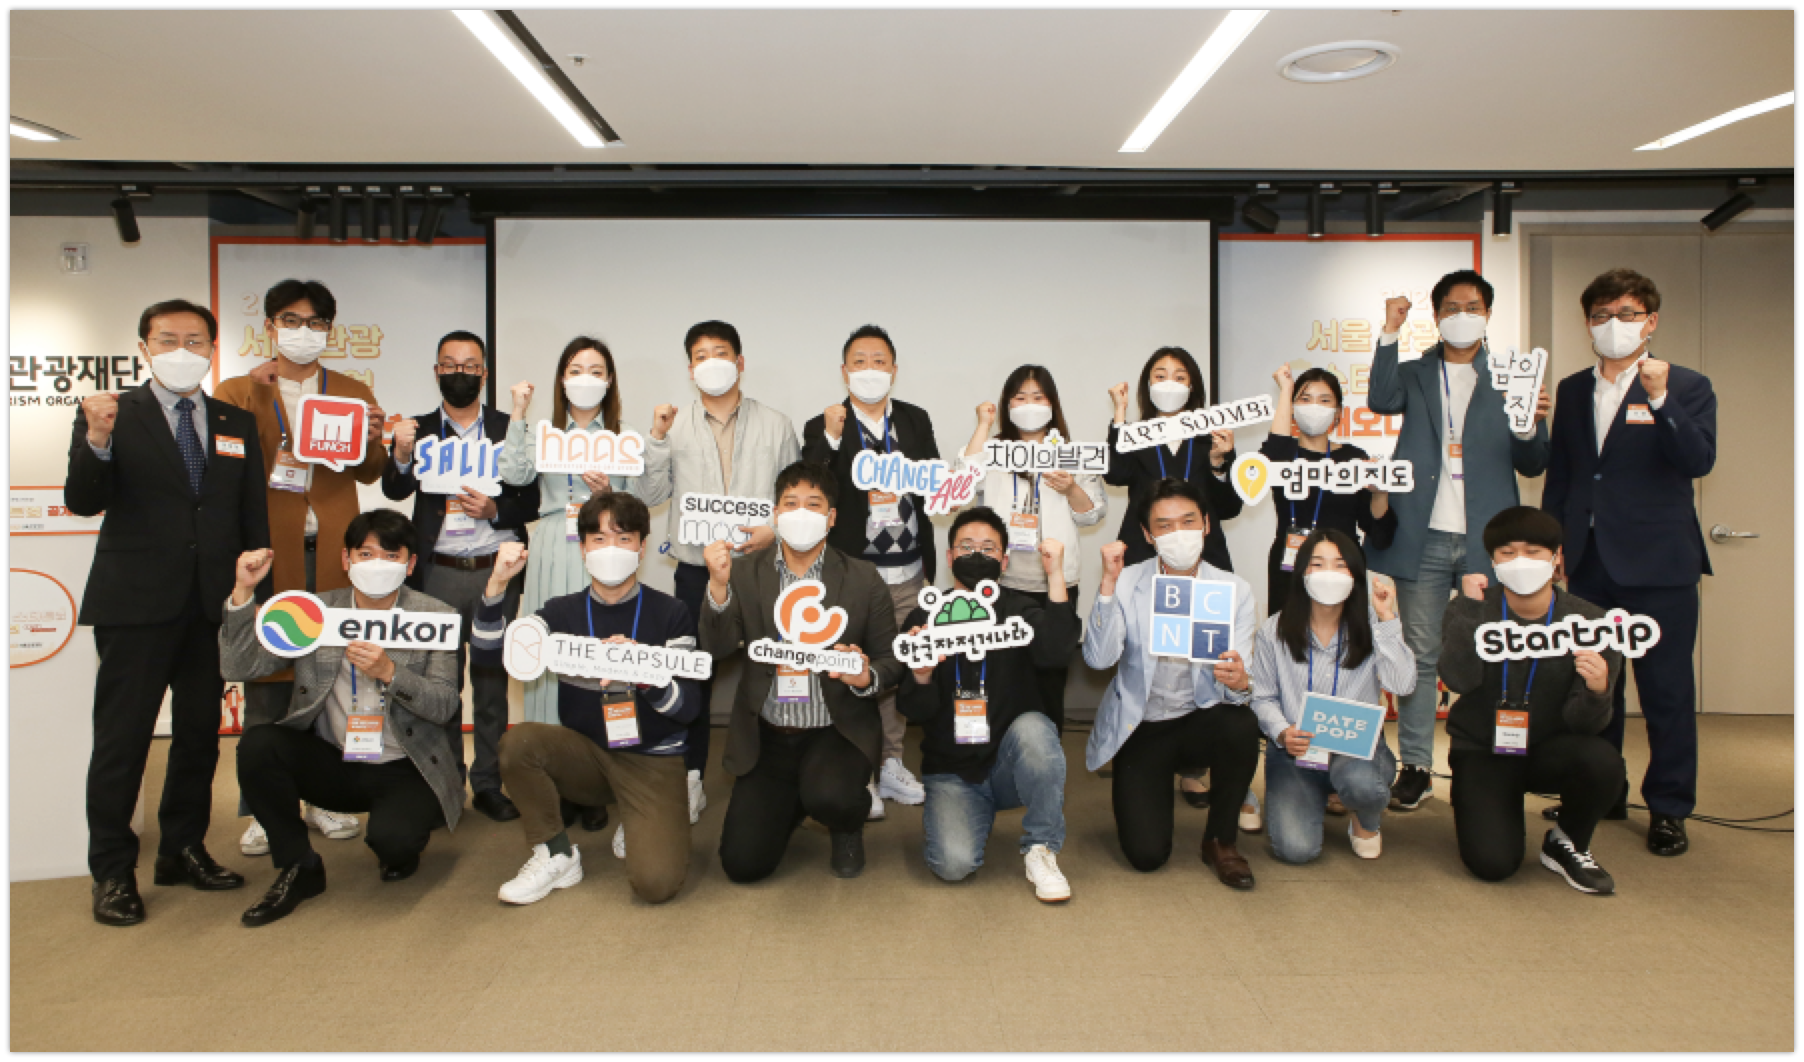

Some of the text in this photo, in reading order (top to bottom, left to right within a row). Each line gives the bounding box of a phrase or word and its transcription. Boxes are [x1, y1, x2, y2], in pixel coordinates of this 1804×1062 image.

[1306, 318, 1372, 353] 서울
[1492, 349, 1542, 389] 남의
[1509, 391, 1535, 428] 집
[309, 440, 352, 453] FUNCH
[541, 423, 641, 464] haas
[1120, 420, 1167, 450] ART
[983, 443, 1105, 471] 차이의발견
[857, 453, 945, 492] CHANGE
[1279, 464, 1409, 494] 엄마의지도
[685, 497, 771, 518] success
[338, 613, 454, 643] enkor
[899, 622, 1028, 663] 한국자전거나라
[555, 639, 706, 674] THE CAPSULE
[1312, 710, 1368, 732] DATE
[1315, 723, 1358, 740] POP
